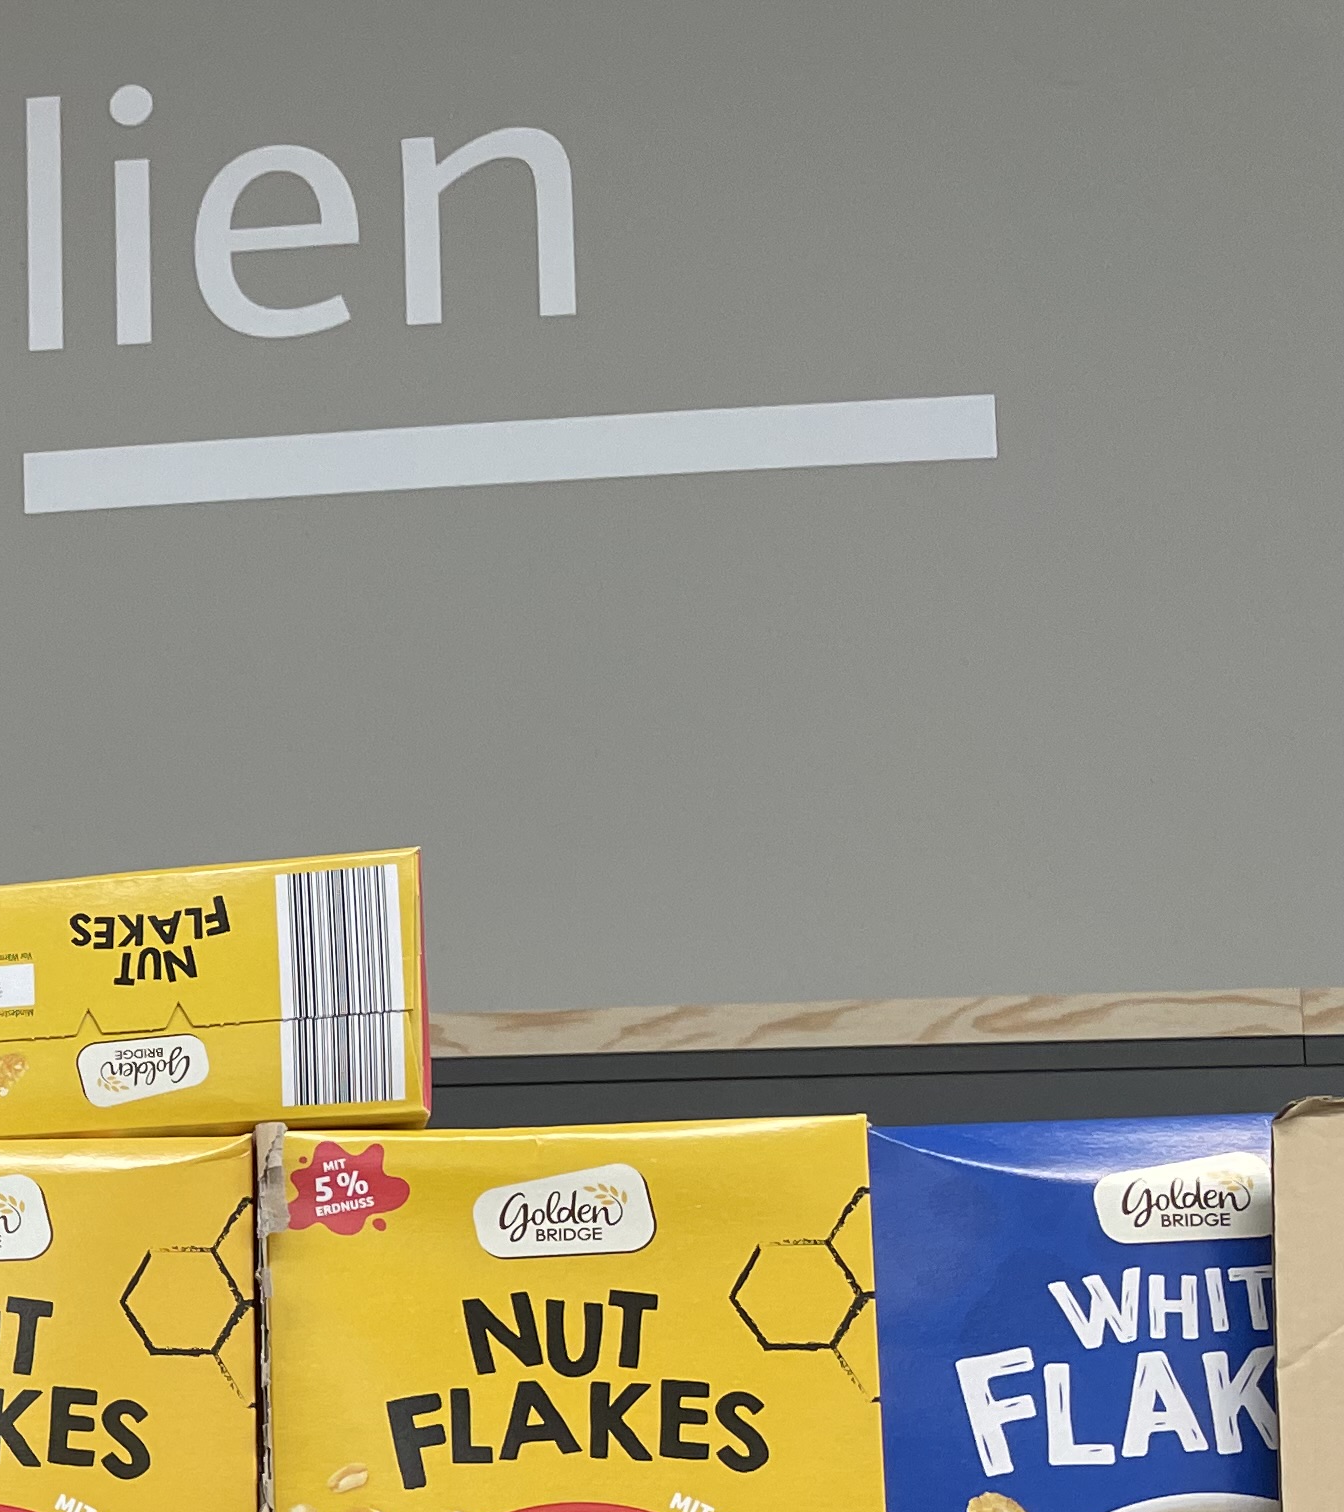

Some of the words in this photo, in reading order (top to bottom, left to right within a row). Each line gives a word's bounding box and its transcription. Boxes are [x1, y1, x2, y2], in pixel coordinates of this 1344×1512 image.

[69, 895, 231, 950] FLAKES
[113, 945, 198, 987] NUT
[100, 1046, 192, 1087] Golden
[114, 1047, 164, 1061] BRIDGE
[322, 1157, 347, 1174] MIT
[315, 1195, 375, 1217] ERDNUSS
[498, 1190, 624, 1242] Golden
[1122, 1182, 1252, 1230] Golden
[1161, 1211, 1232, 1227] BRIDGE
[535, 1226, 603, 1242] BRIDGE
[1048, 1264, 1272, 1350] WHIT
[462, 1289, 659, 1377] NUT
[955, 1345, 1277, 1477] FLAK
[386, 1379, 770, 1490] FLAKES
